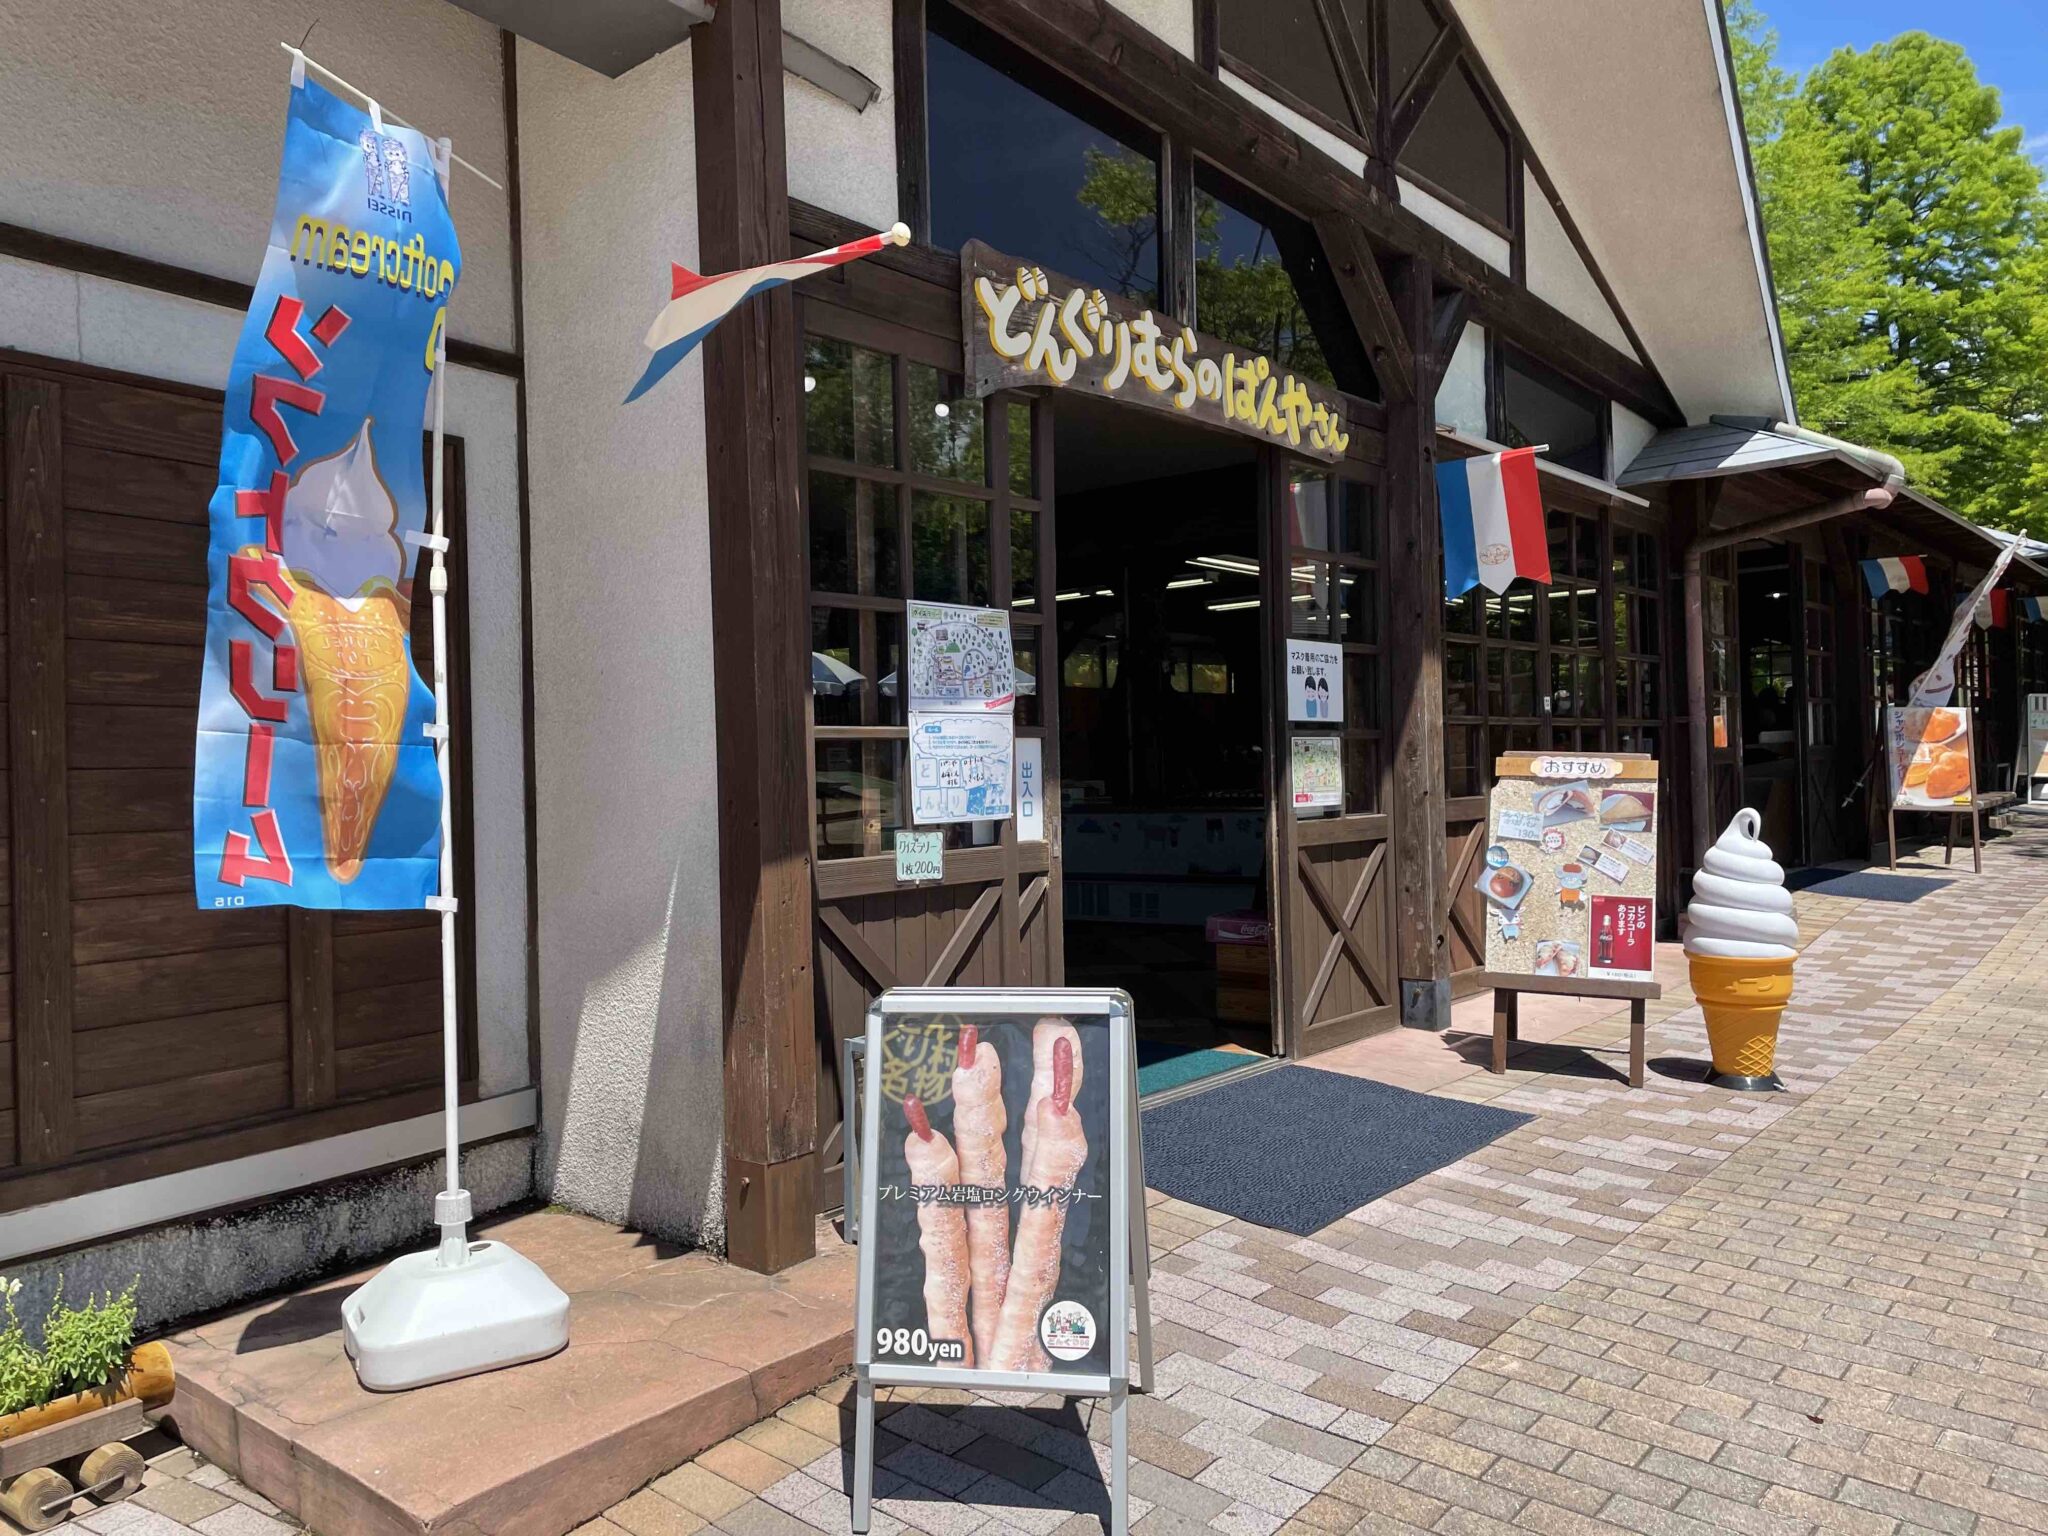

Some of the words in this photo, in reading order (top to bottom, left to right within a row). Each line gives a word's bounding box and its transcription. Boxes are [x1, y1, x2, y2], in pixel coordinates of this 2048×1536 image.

[974, 266, 1350, 453] どんぐりむらのぱんやさん
[1544, 760, 1606, 775] おすすめ
[1021, 761, 1033, 817] 出入口
[899, 838, 937, 854] クイズラリー
[1617, 904, 1627, 936] あります
[1636, 904, 1646, 929] ビンの
[878, 1184, 1103, 1205] プレミアム岩塩ロングウインナー
[876, 1327, 963, 1360] 980yen
